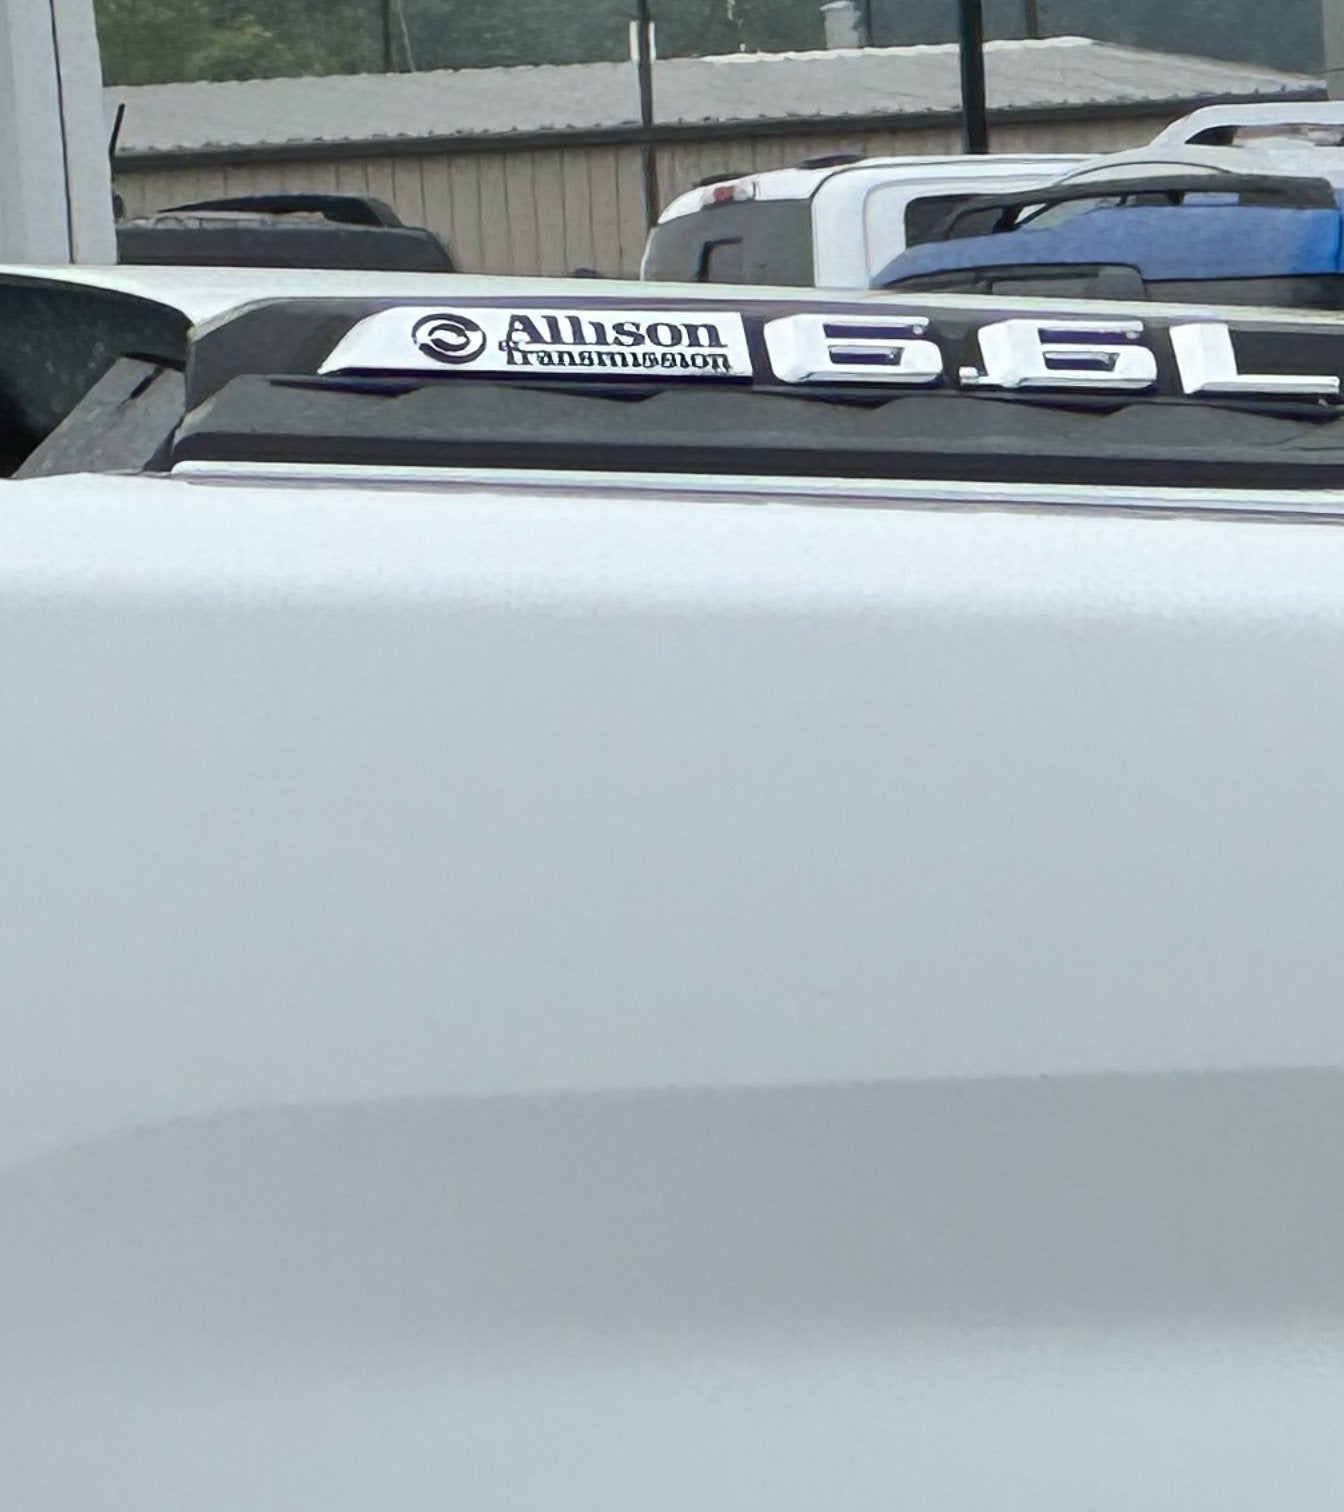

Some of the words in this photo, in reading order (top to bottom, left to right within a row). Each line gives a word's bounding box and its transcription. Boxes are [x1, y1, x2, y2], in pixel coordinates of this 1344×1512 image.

[506, 313, 728, 348] Allison
[498, 342, 732, 372] Transmission
[763, 312, 1341, 395] 6.6L
